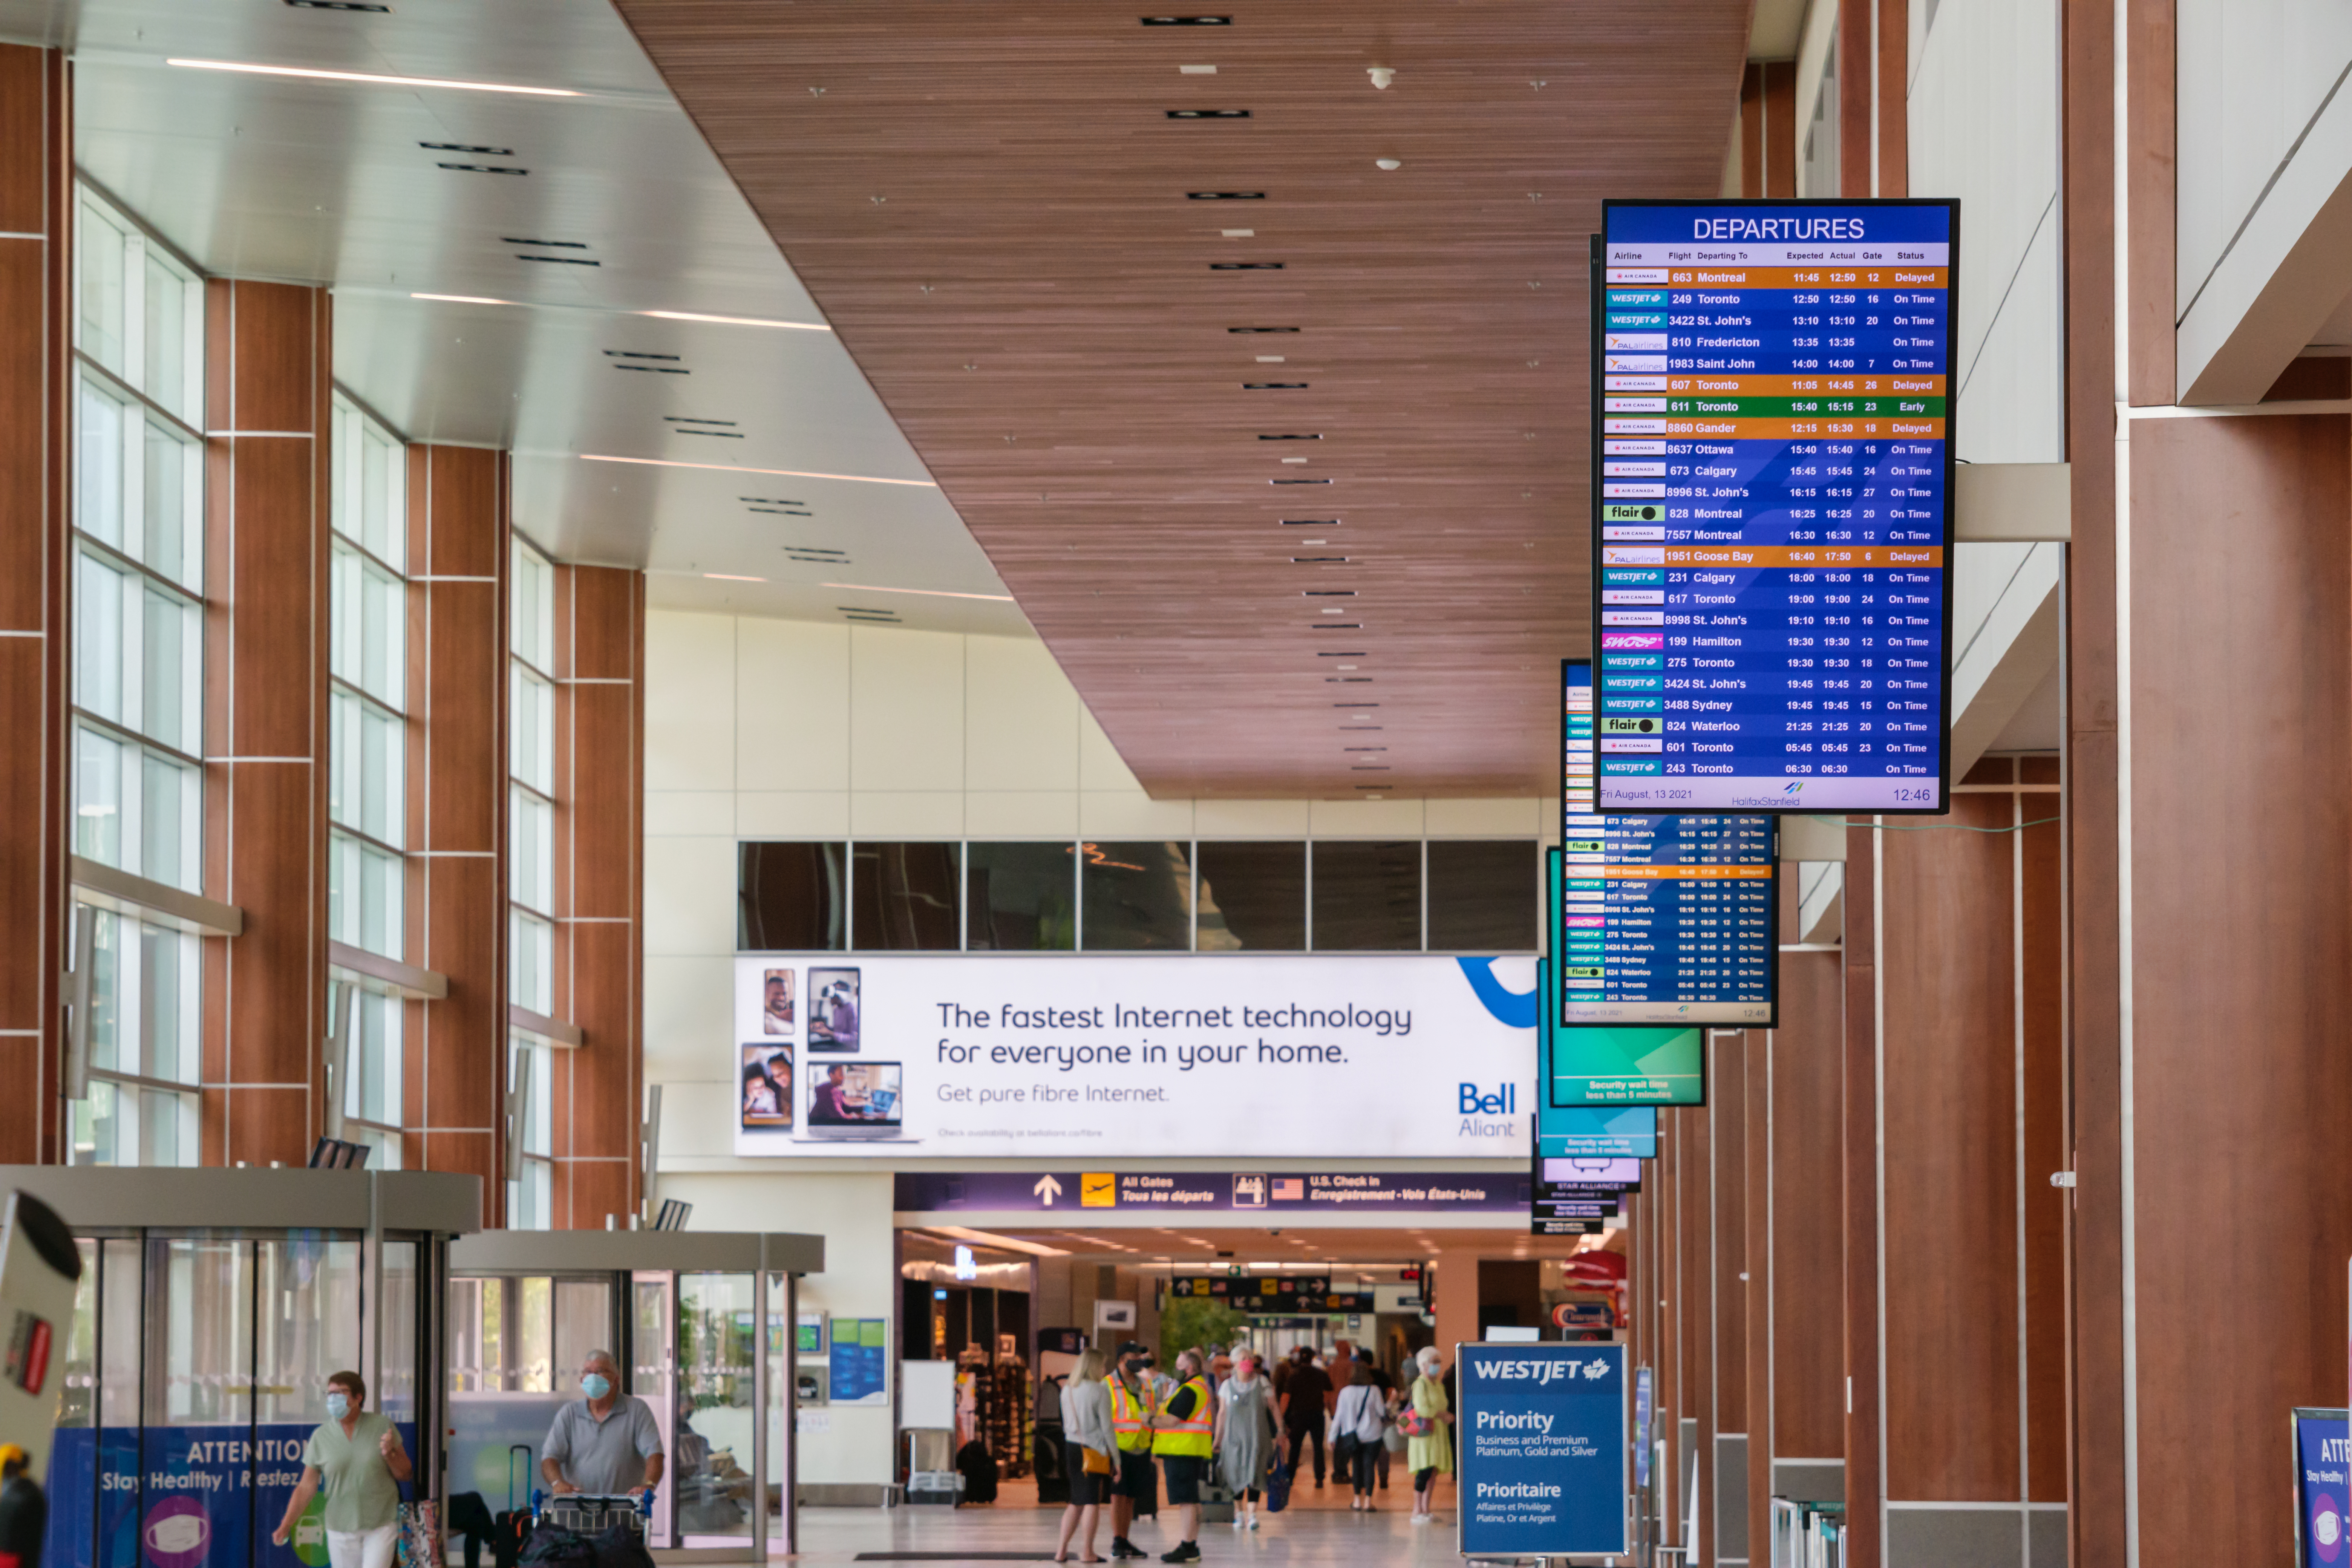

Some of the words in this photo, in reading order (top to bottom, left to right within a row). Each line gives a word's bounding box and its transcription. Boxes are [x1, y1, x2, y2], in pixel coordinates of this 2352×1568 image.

[1694, 218, 1864, 239] DEPARTURES
[1669, 252, 1691, 261] Flight
[1698, 252, 1736, 261] Departing
[1787, 252, 1824, 260] Expected
[1672, 273, 1692, 282] 663
[1698, 273, 1746, 282] Montreal
[1794, 273, 1819, 282] 11:45
[1830, 273, 1856, 282] 12:50
[1868, 273, 1879, 282] 12
[1895, 273, 1934, 283] Delayed
[1612, 294, 1651, 305] WESTJET
[1672, 294, 1692, 304] 249
[1697, 294, 1740, 304] Toronto
[1793, 295, 1819, 303] 12:50
[1830, 295, 1855, 303] 12:50
[1867, 295, 1879, 303] 16
[1894, 295, 1908, 303] On
[1911, 295, 1935, 303] Time
[1672, 337, 1691, 347] 810
[1697, 337, 1759, 347] Fredericton
[1793, 338, 1818, 346] 13:35
[1829, 338, 1854, 346] 13:35
[1671, 402, 1689, 411] 611
[1696, 402, 1738, 411] Toronto
[1792, 403, 1817, 411] 15:40
[1828, 403, 1853, 411] 15:15
[1865, 403, 1876, 411] 23
[1900, 403, 1925, 413] Early
[1612, 506, 1639, 517] flair
[1669, 509, 1689, 518] 828
[1695, 509, 1742, 518] Montreal
[1790, 510, 1816, 518] 16:25
[1826, 510, 1851, 518] 16:25
[1863, 510, 1875, 518] 20
[1890, 510, 1904, 518] On
[1907, 510, 1931, 518] Time
[1668, 637, 1687, 646] 199
[1693, 637, 1741, 646] Hamilton
[1788, 637, 1813, 646] 19:30
[1600, 790, 1612, 799] Fri
[1614, 790, 1651, 801] August,
[1655, 790, 1666, 798] 13
[1669, 790, 1691, 799] 2021
[1894, 789, 1930, 801] 12:46
[1732, 797, 1800, 806] HalifaxStanfield
[937, 1003, 990, 1028] The
[1002, 1004, 1104, 1028] fastest
[1115, 1003, 1233, 1028] Internet
[1244, 1003, 1411, 1036] technology
[938, 1038, 981, 1063] for
[991, 1046, 1131, 1072] everyone
[1143, 1039, 1167, 1063] in
[1178, 1045, 1248, 1071] your
[1258, 1038, 1348, 1063] home.
[1589, 1080, 1627, 1091] Security
[1628, 1080, 1647, 1089] wait
[1649, 1080, 1669, 1089] time
[937, 1083, 972, 1102] Get
[979, 1089, 1026, 1106] pure
[1032, 1084, 1079, 1102] fibre
[1086, 1084, 1169, 1102] Internet.
[1459, 1083, 1515, 1115] Bell
[1586, 1091, 1604, 1099] less
[1606, 1090, 1626, 1099] than
[1636, 1090, 1672, 1099] minutes
[1459, 1118, 1515, 1138] Aliant
[1122, 1176, 1138, 1187] All
[1140, 1176, 1174, 1188] Gates
[1309, 1175, 1332, 1187] U.S.
[1333, 1175, 1367, 1187] Check
[1369, 1176, 1380, 1187] in
[1122, 1190, 1150, 1202] Tous
[1151, 1190, 1169, 1202] les
[1170, 1190, 1214, 1204] départs
[1310, 1189, 1396, 1203] Enregistrement
[1402, 1189, 1426, 1200] Vols
[1474, 1360, 1582, 1386] WESTJET
[1477, 1410, 1554, 1433] Priority
[1476, 1435, 1519, 1445] Business
[1521, 1435, 1540, 1445] and
[1542, 1435, 1588, 1445] Premium
[187, 1439, 308, 1464] ATTENTIO
[1476, 1446, 1522, 1457] Platinum,
[1524, 1446, 1548, 1456] Gold
[1550, 1446, 1570, 1456] and
[1571, 1446, 1598, 1456] Silver
[151, 1470, 223, 1493] Healthy
[2306, 1470, 2320, 1484] Stay
[2320, 1470, 2343, 1485] Healthy
[1477, 1482, 1561, 1498] Prioritaire
[1476, 1502, 1507, 1511] Affaires
[1517, 1502, 1551, 1513] Privilège
[1476, 1514, 1505, 1523] Platine,
[1507, 1514, 1517, 1522] Or
[1528, 1514, 1556, 1524] Argent
